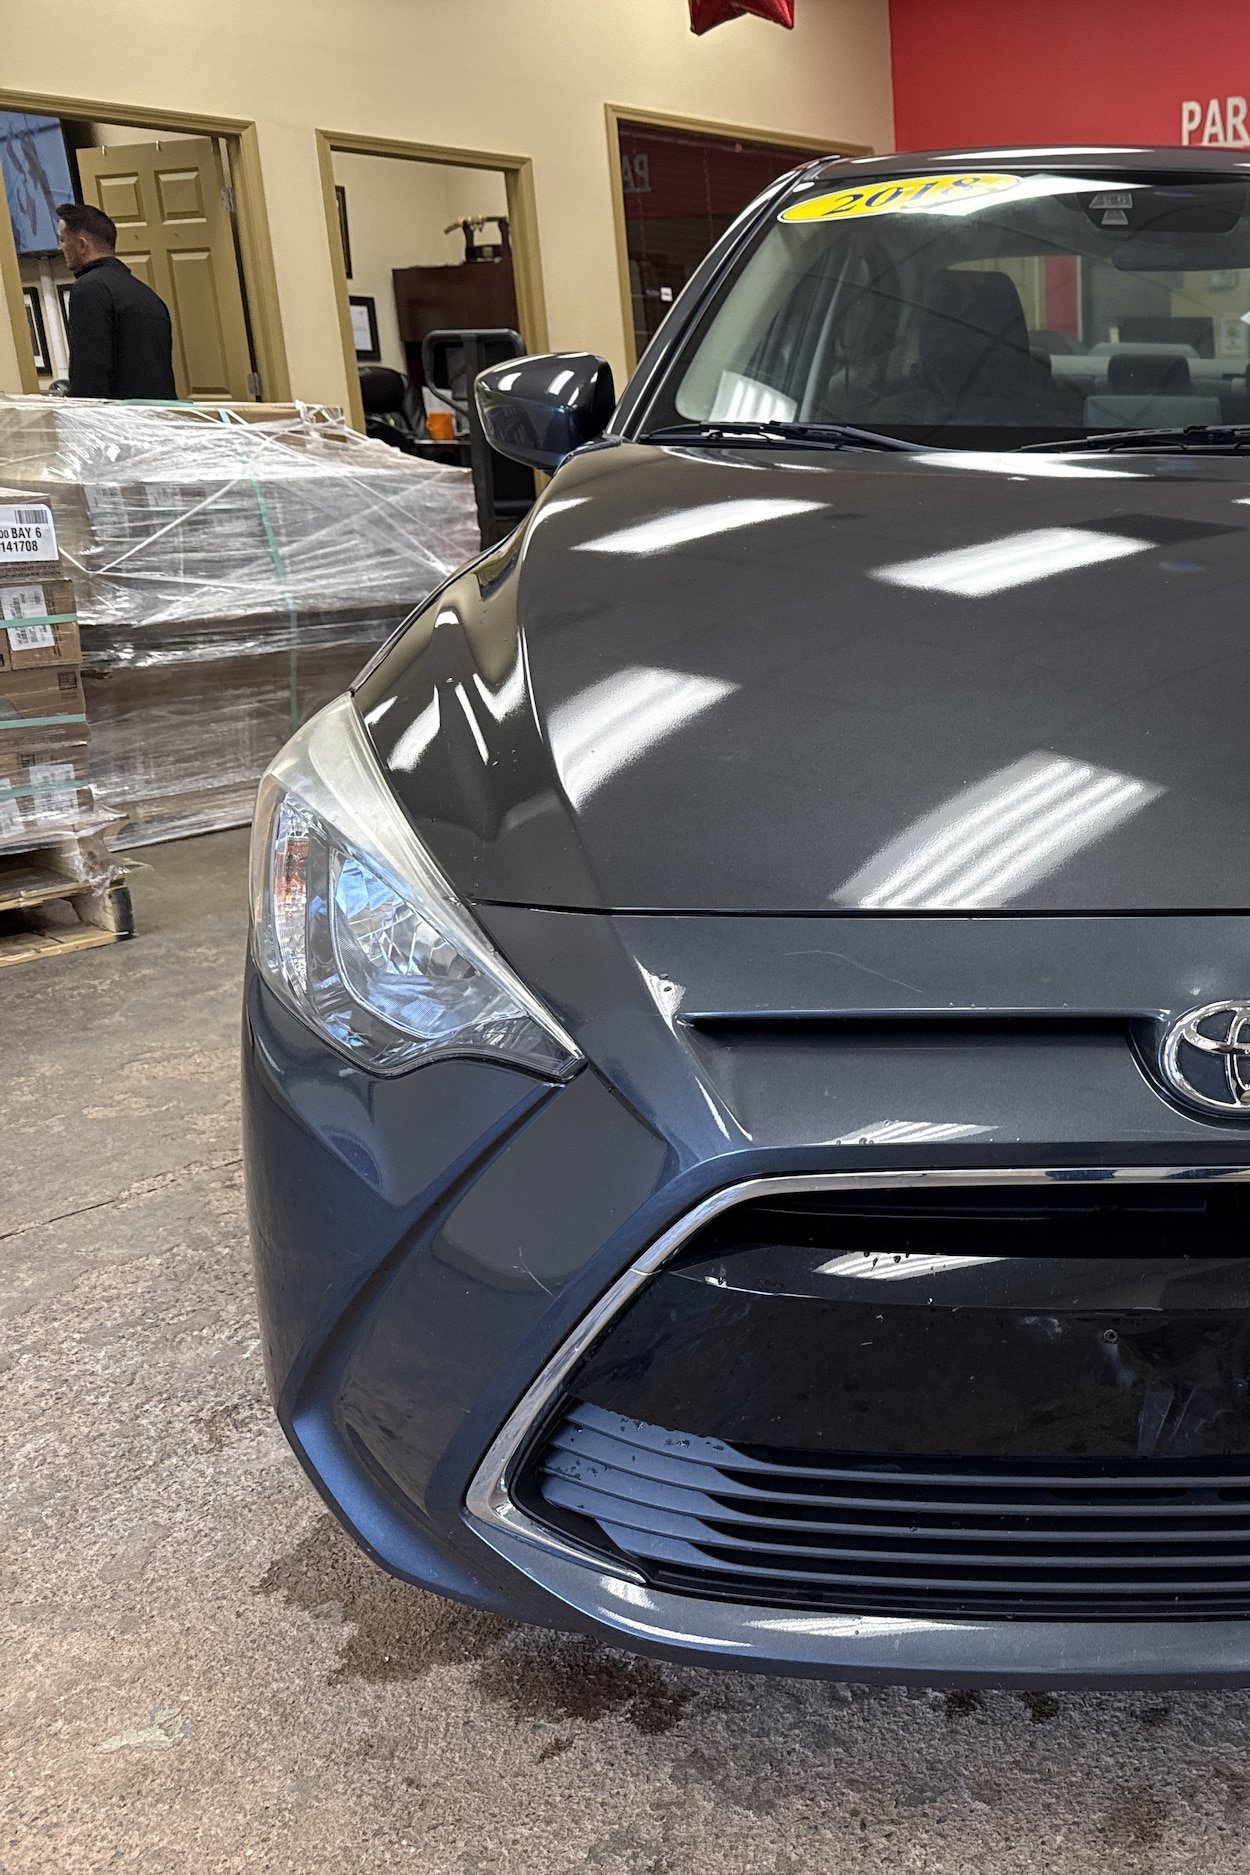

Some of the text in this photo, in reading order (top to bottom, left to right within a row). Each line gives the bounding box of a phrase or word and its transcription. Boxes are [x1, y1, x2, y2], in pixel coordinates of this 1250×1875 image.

[821, 177, 981, 216] 2018
[11, 527, 31, 539] BAY
[35, 527, 42, 538] 6
[0, 540, 38, 552] 141708
